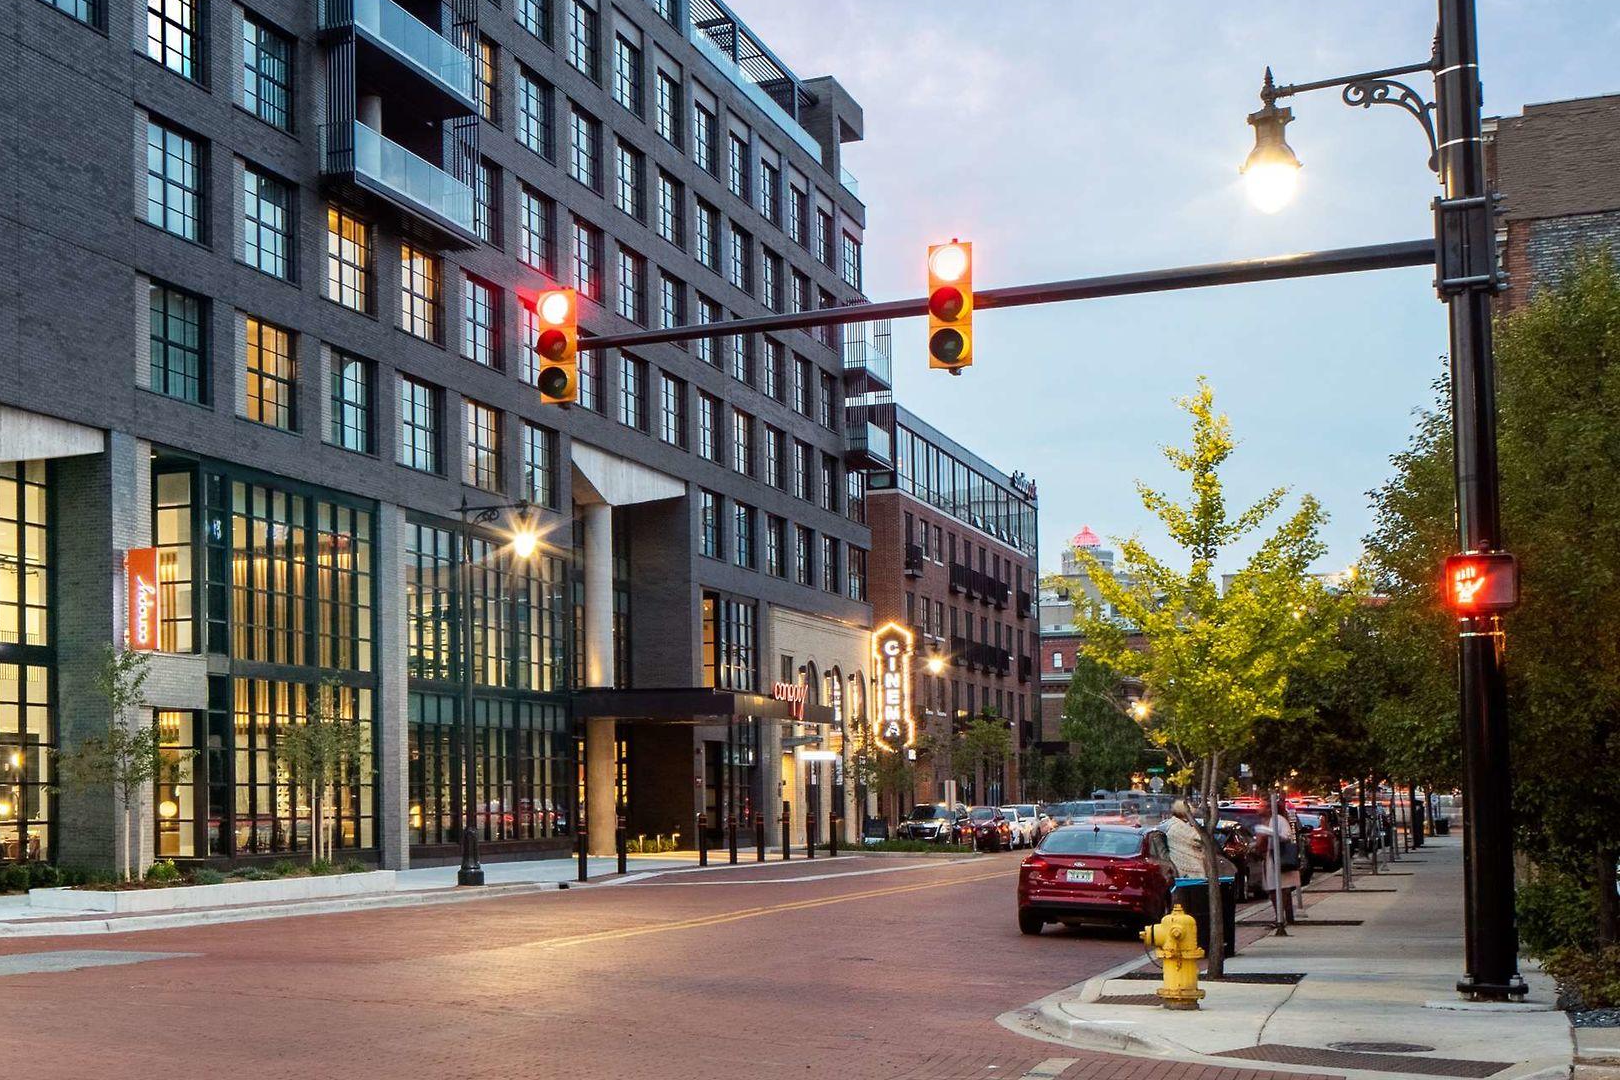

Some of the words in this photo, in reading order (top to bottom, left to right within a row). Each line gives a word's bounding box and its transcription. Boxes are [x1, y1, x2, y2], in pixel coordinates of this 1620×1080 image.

[137, 575, 156, 644] canopy
[774, 682, 808, 720] canopy
[884, 640, 901, 737] CINEMA
